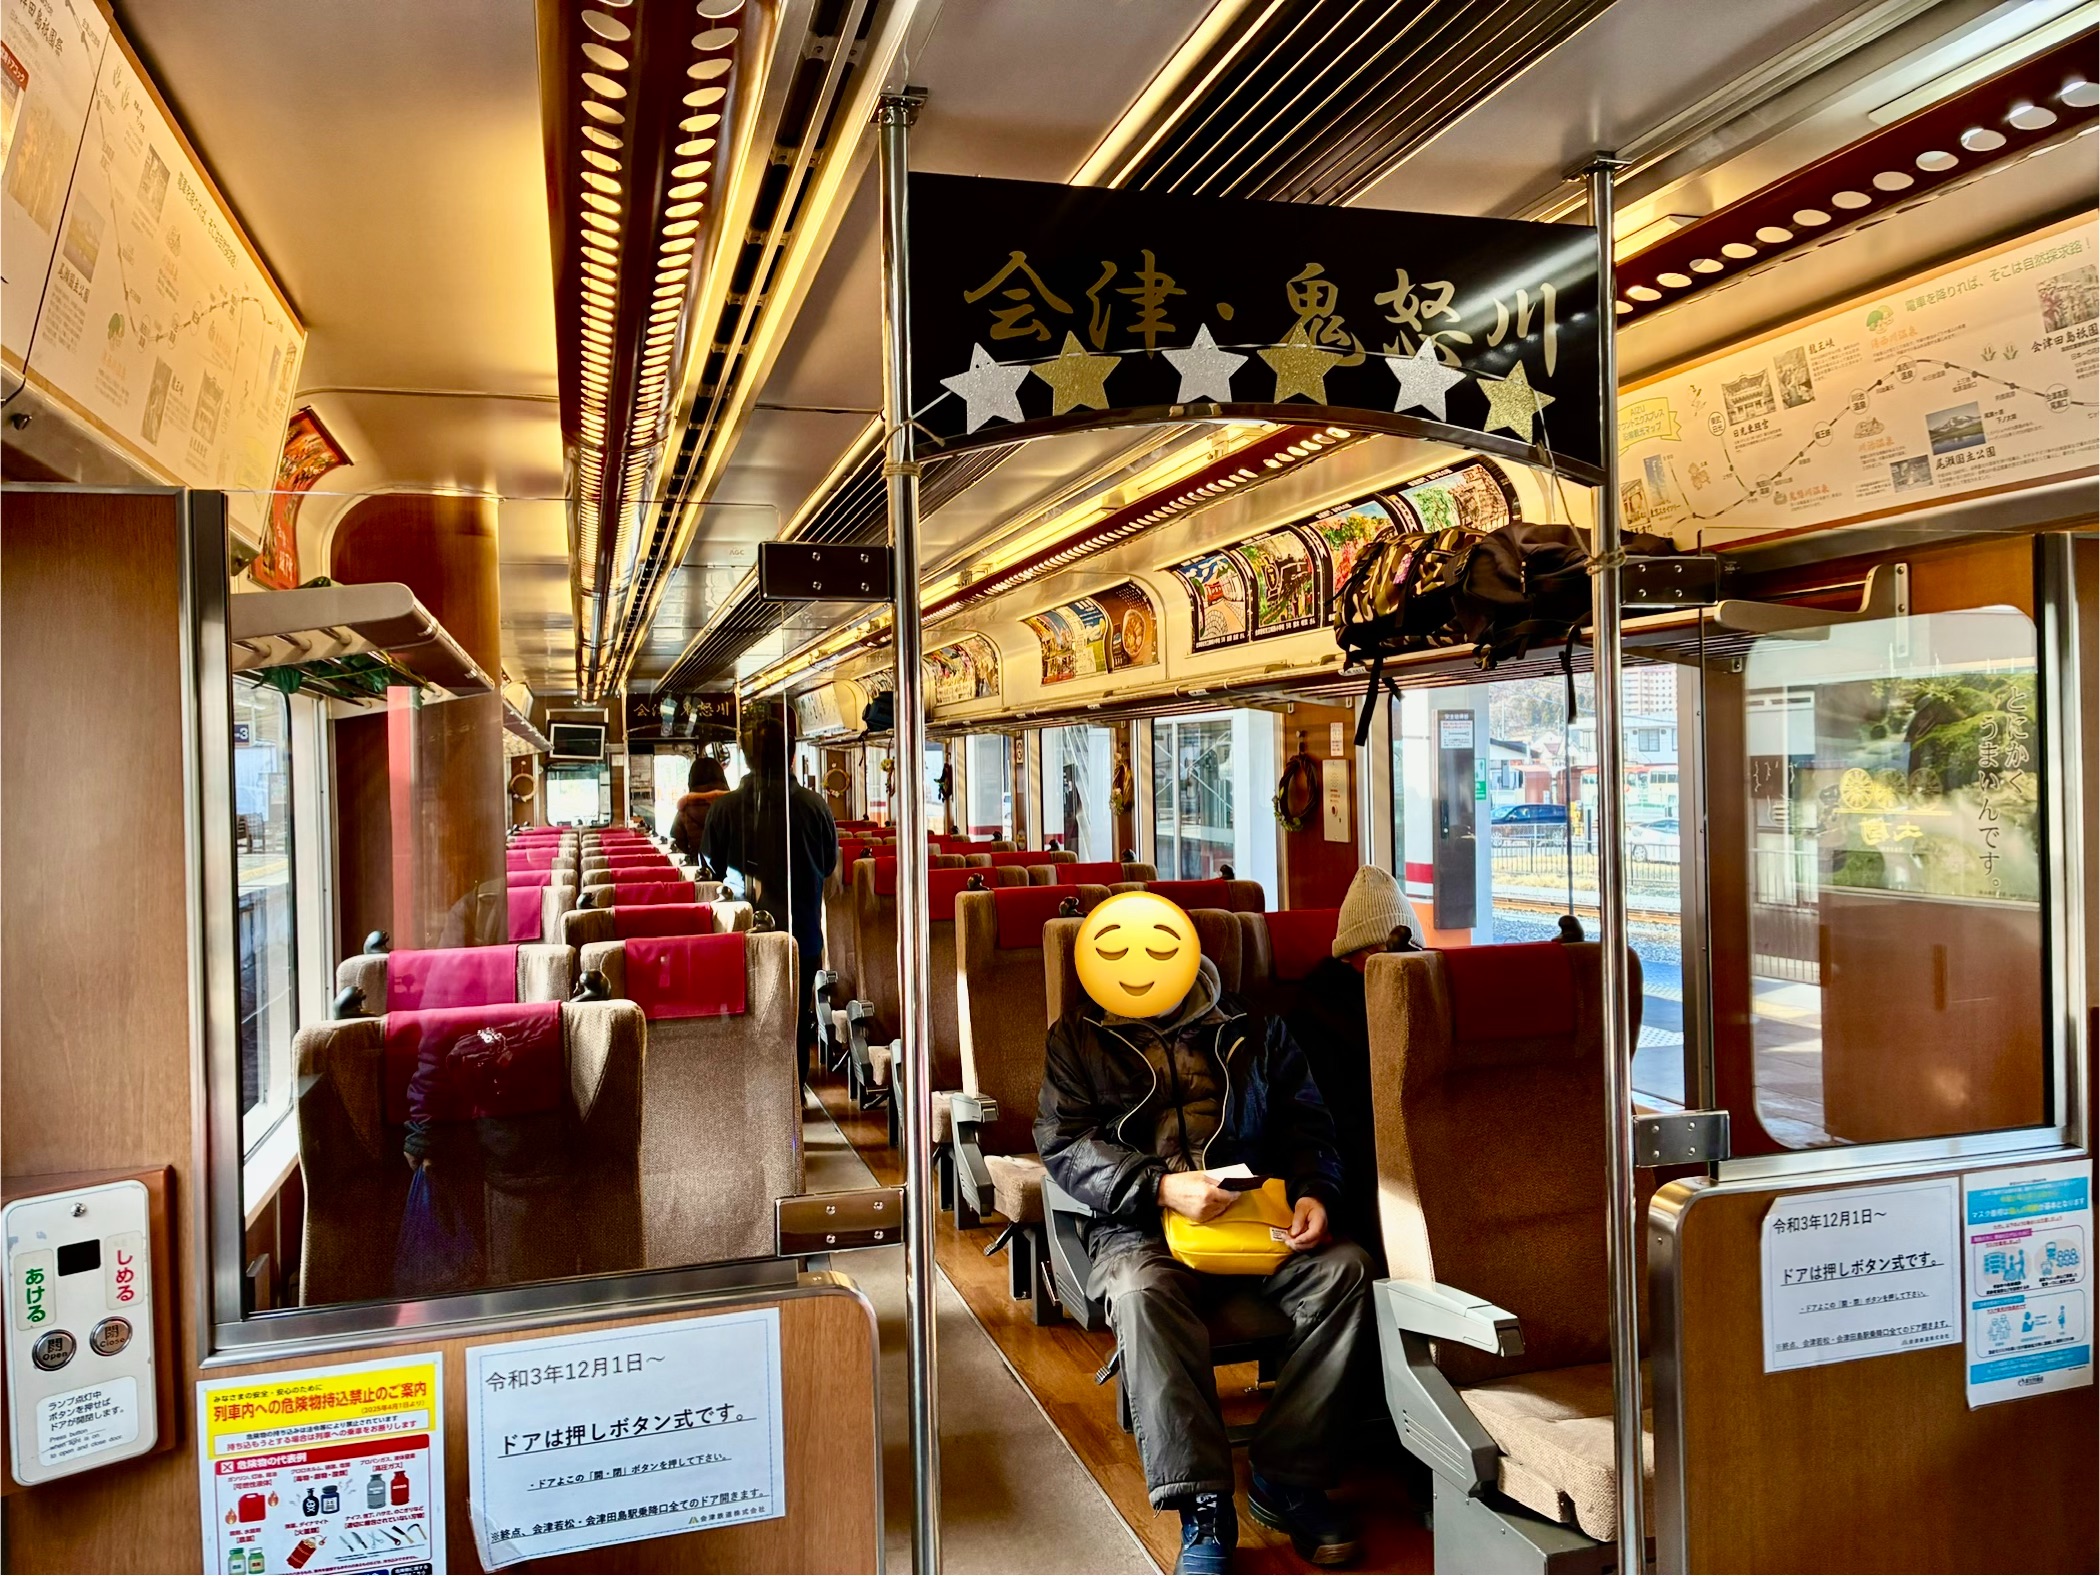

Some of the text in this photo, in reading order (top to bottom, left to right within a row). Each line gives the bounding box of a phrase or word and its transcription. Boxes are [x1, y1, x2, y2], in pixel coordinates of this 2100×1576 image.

[2005, 687, 2030, 795] とにかく
[1978, 716, 2001, 888] うまいんです。
[116, 1250, 135, 1302] しめる
[1781, 1251, 1937, 1284] ドアは押しボタン式です。
[26, 1268, 46, 1322] あける
[42, 1350, 69, 1361] Open
[48, 1391, 102, 1411] ランプ点灯中
[213, 1384, 324, 1402] みなさまの安全・安心のために
[213, 1381, 427, 1422] 列車内への危険物持込禁止のご案内
[502, 1402, 747, 1455] ドアは押しボタン式です。
